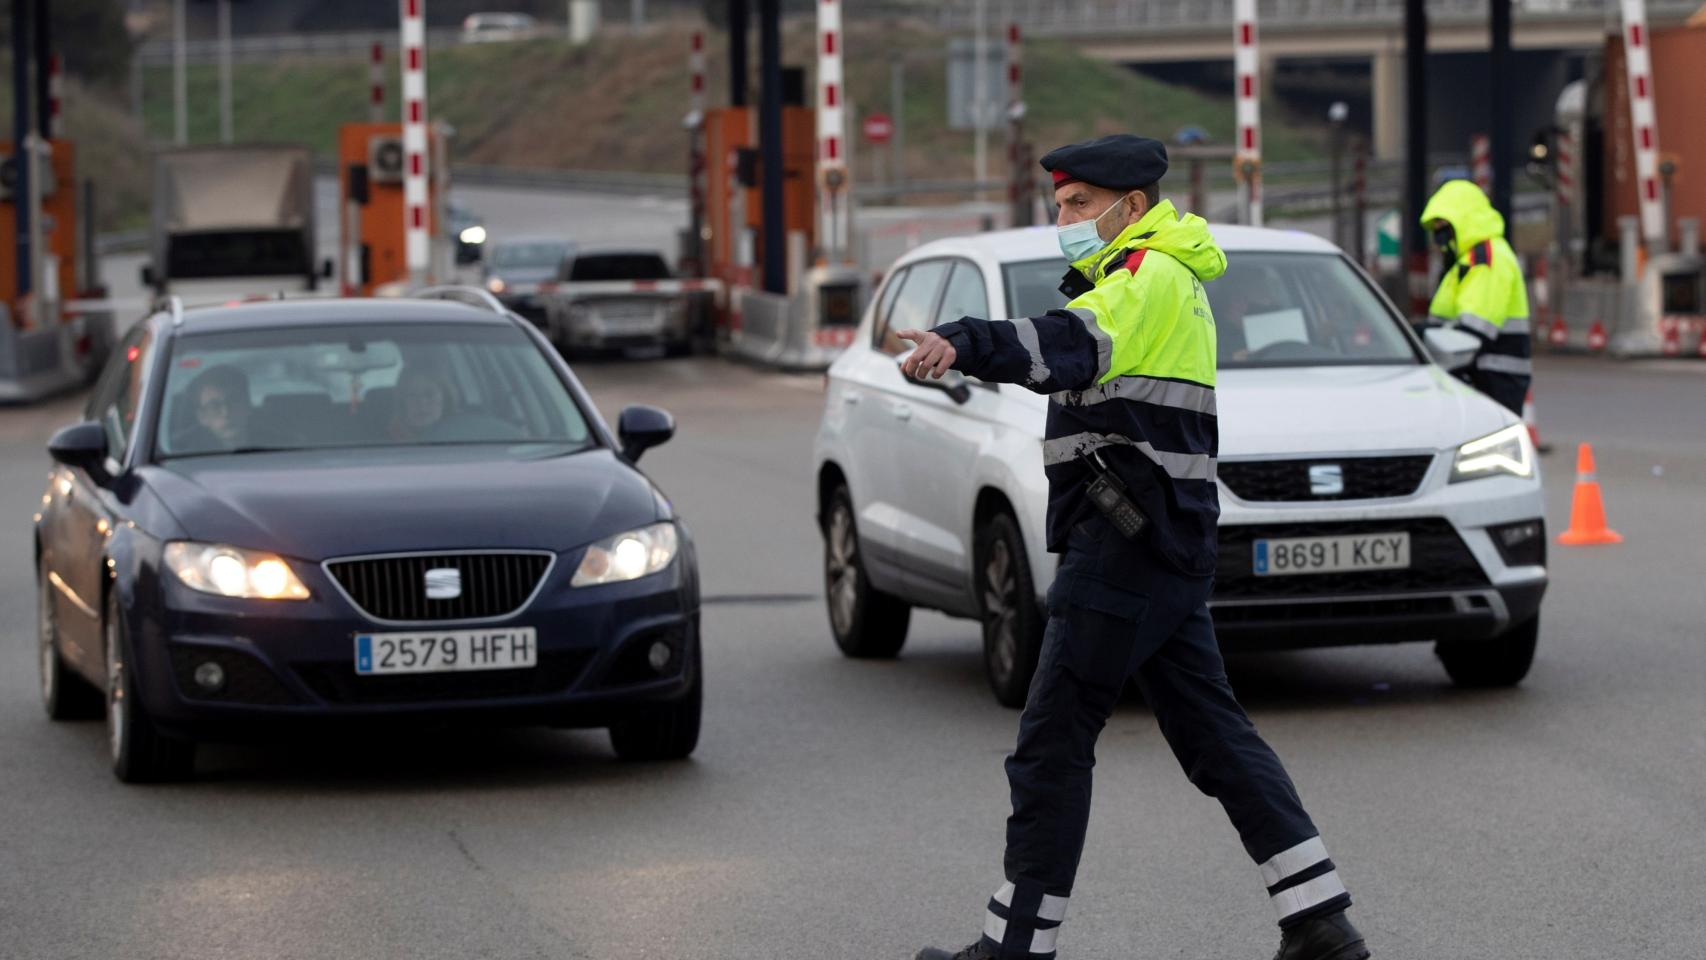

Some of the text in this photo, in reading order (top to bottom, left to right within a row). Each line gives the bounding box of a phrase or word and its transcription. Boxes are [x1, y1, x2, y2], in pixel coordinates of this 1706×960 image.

[1274, 538, 1403, 569] 8691 KCY
[379, 634, 528, 669] 2579 HFH
